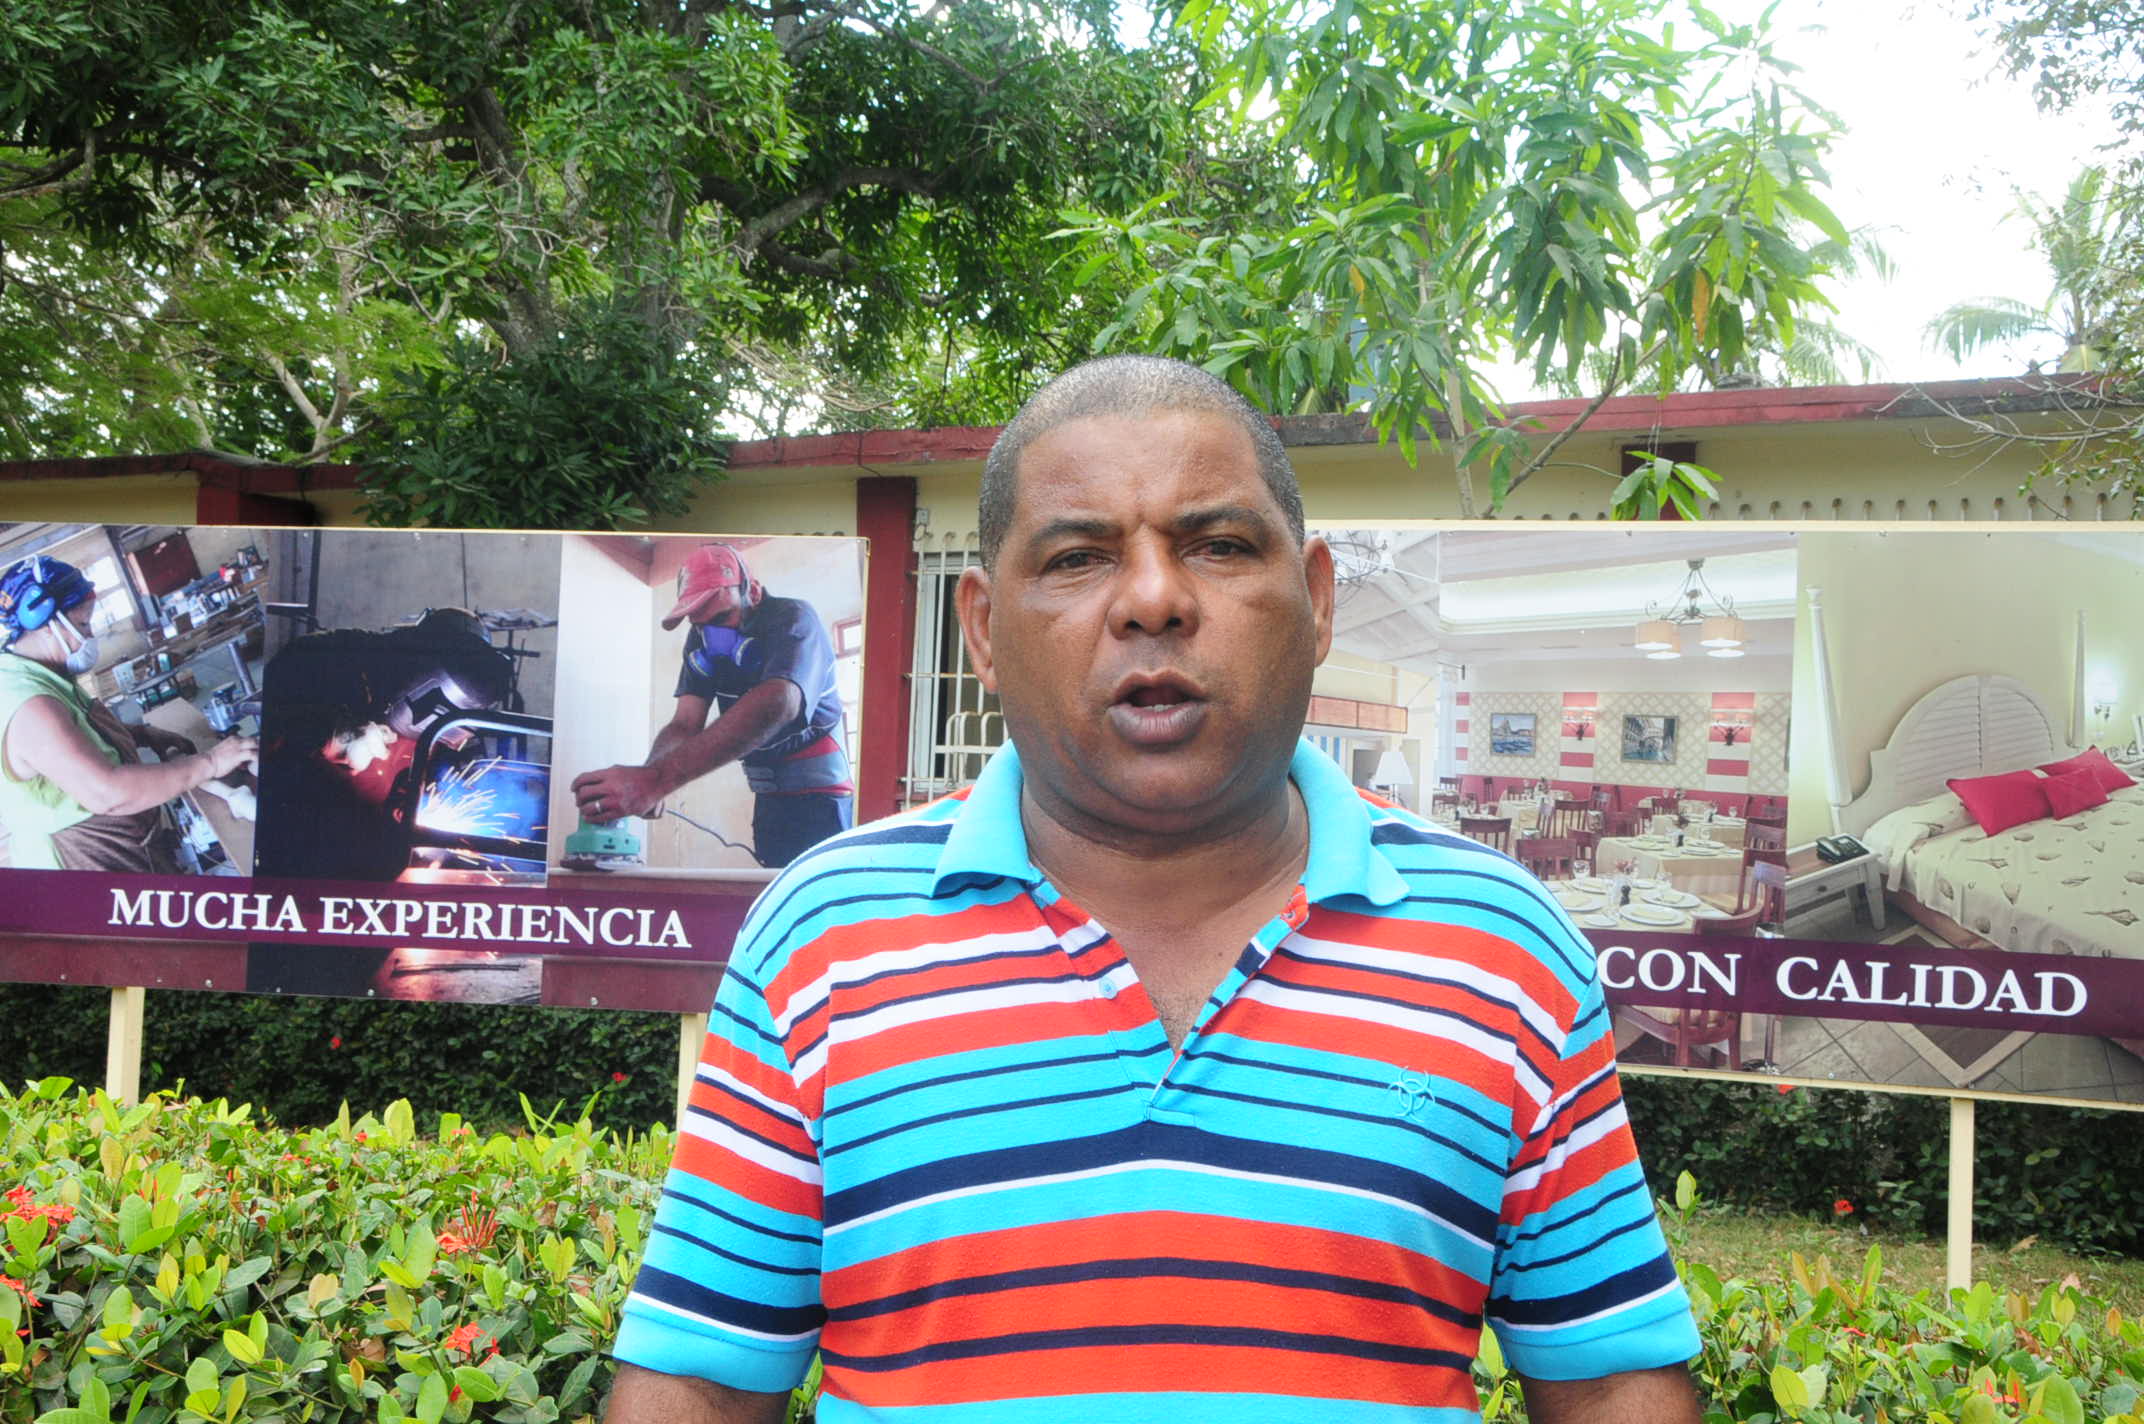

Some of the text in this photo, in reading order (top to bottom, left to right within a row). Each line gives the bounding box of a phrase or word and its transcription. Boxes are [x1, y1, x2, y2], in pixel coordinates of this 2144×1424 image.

[108, 889, 692, 948] MUCHA EXPERIENCIA
[1597, 946, 2088, 1017] CON CALIDAD
